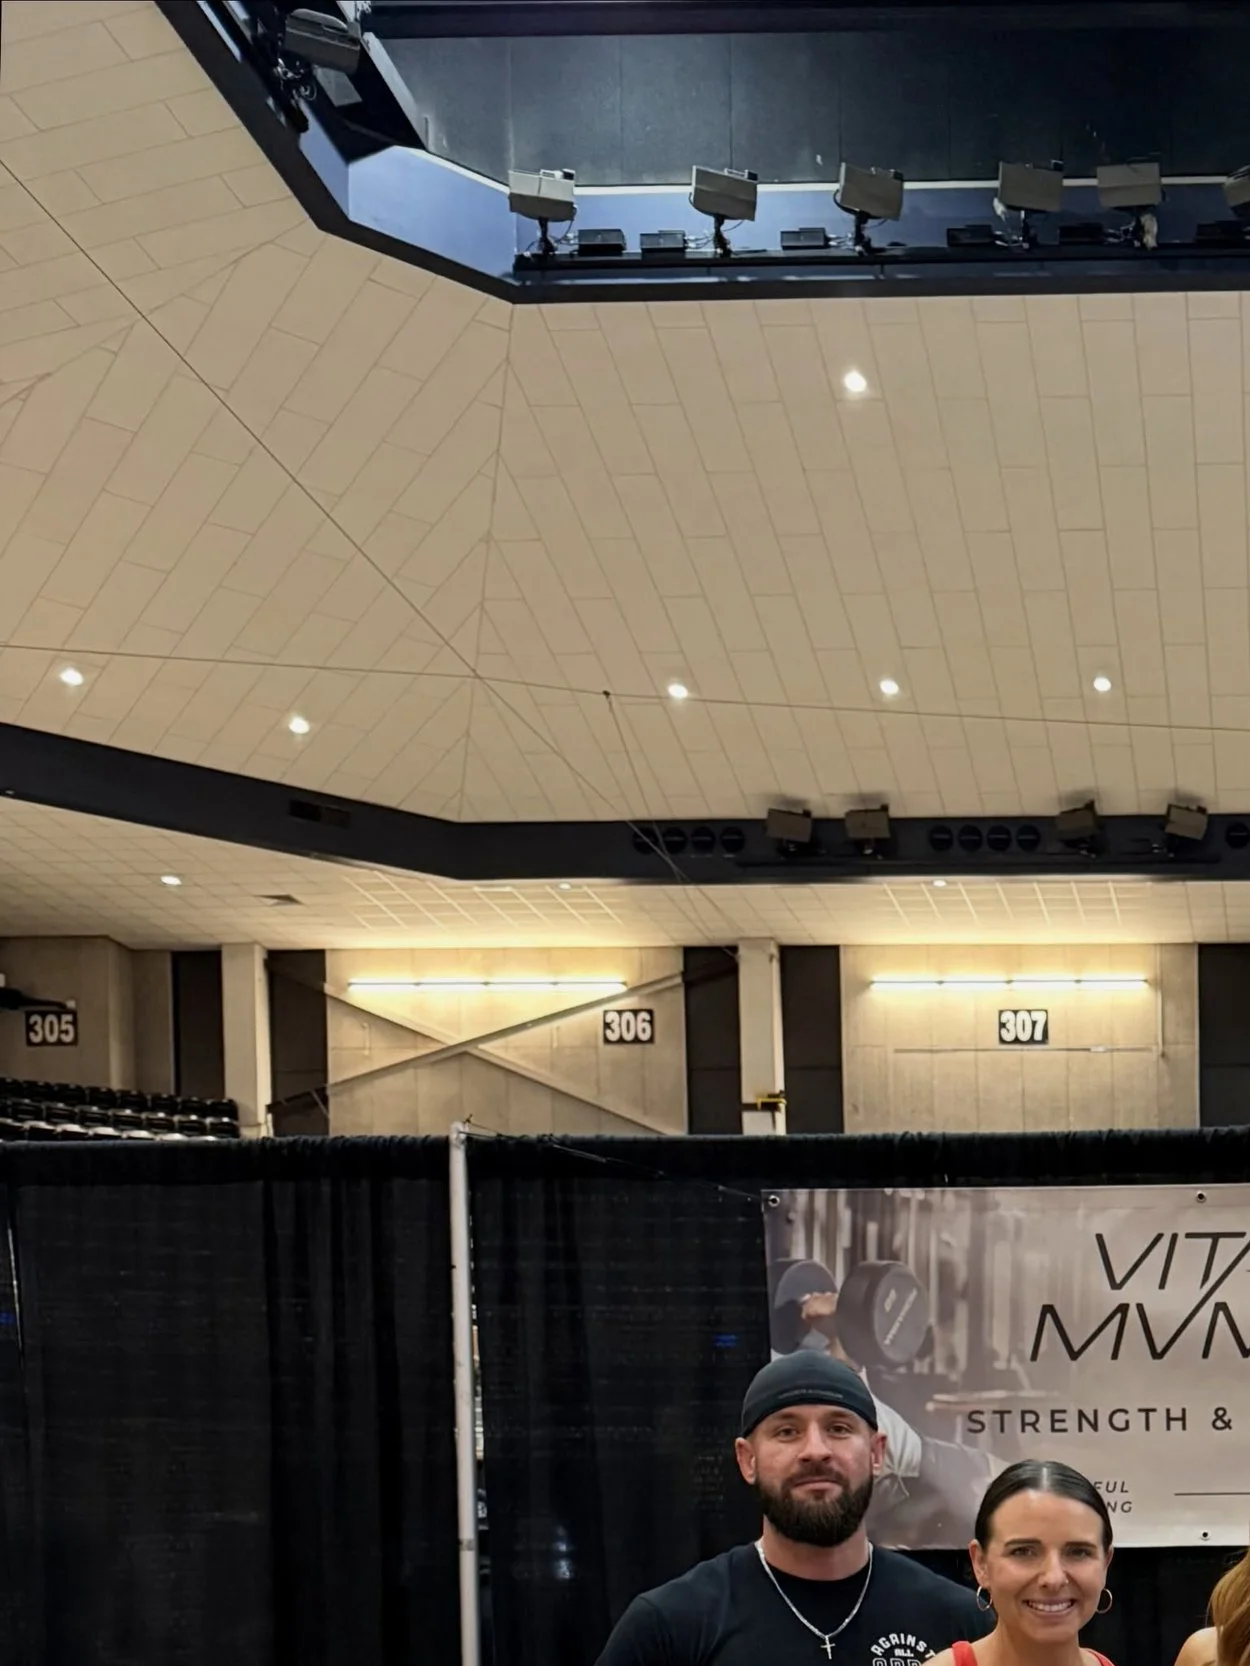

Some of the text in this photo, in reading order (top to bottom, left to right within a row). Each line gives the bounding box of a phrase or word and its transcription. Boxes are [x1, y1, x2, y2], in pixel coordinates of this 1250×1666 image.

[29, 1014, 74, 1044] 305
[605, 1011, 651, 1043] 306
[1000, 1011, 1047, 1042] 307
[967, 1408, 1188, 1434] STRENGTH
[1212, 1407, 1233, 1431] &
[871, 1633, 935, 1659] AGAINST
[894, 1648, 914, 1657] ALL
